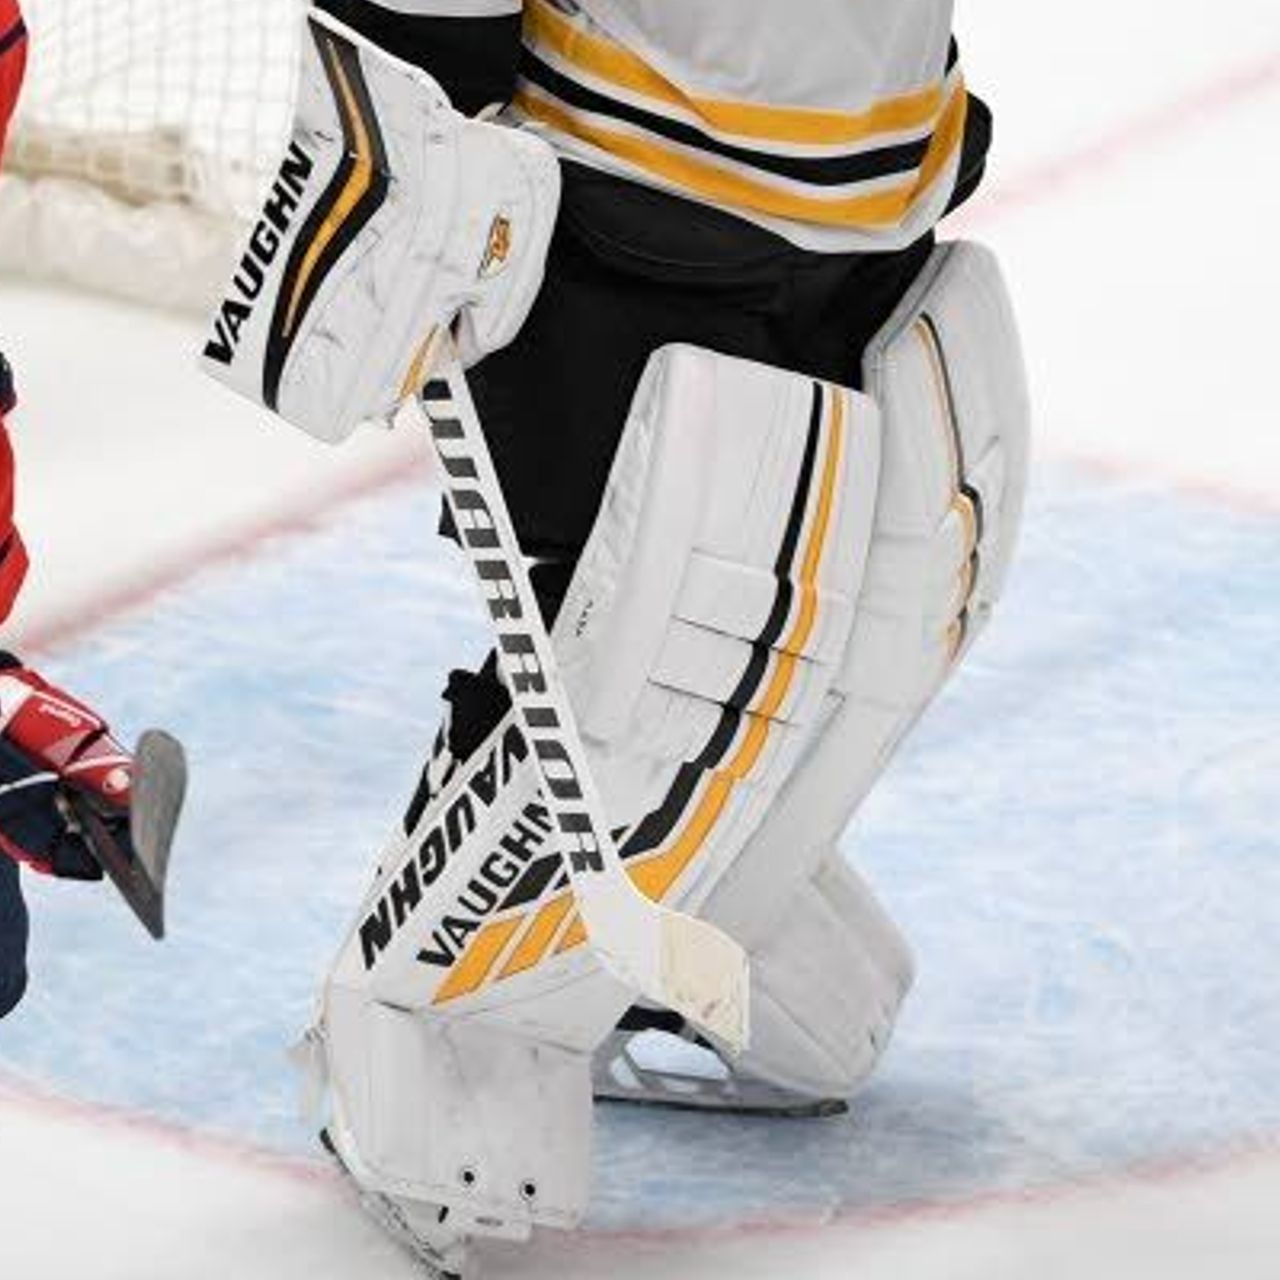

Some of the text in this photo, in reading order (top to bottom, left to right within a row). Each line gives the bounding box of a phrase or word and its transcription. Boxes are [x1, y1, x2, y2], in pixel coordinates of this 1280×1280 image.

[204, 140, 314, 365] VAUGHN
[422, 379, 604, 873] WARRIOR
[359, 723, 528, 970] VAUGHN
[416, 788, 553, 967] VAUGHN
